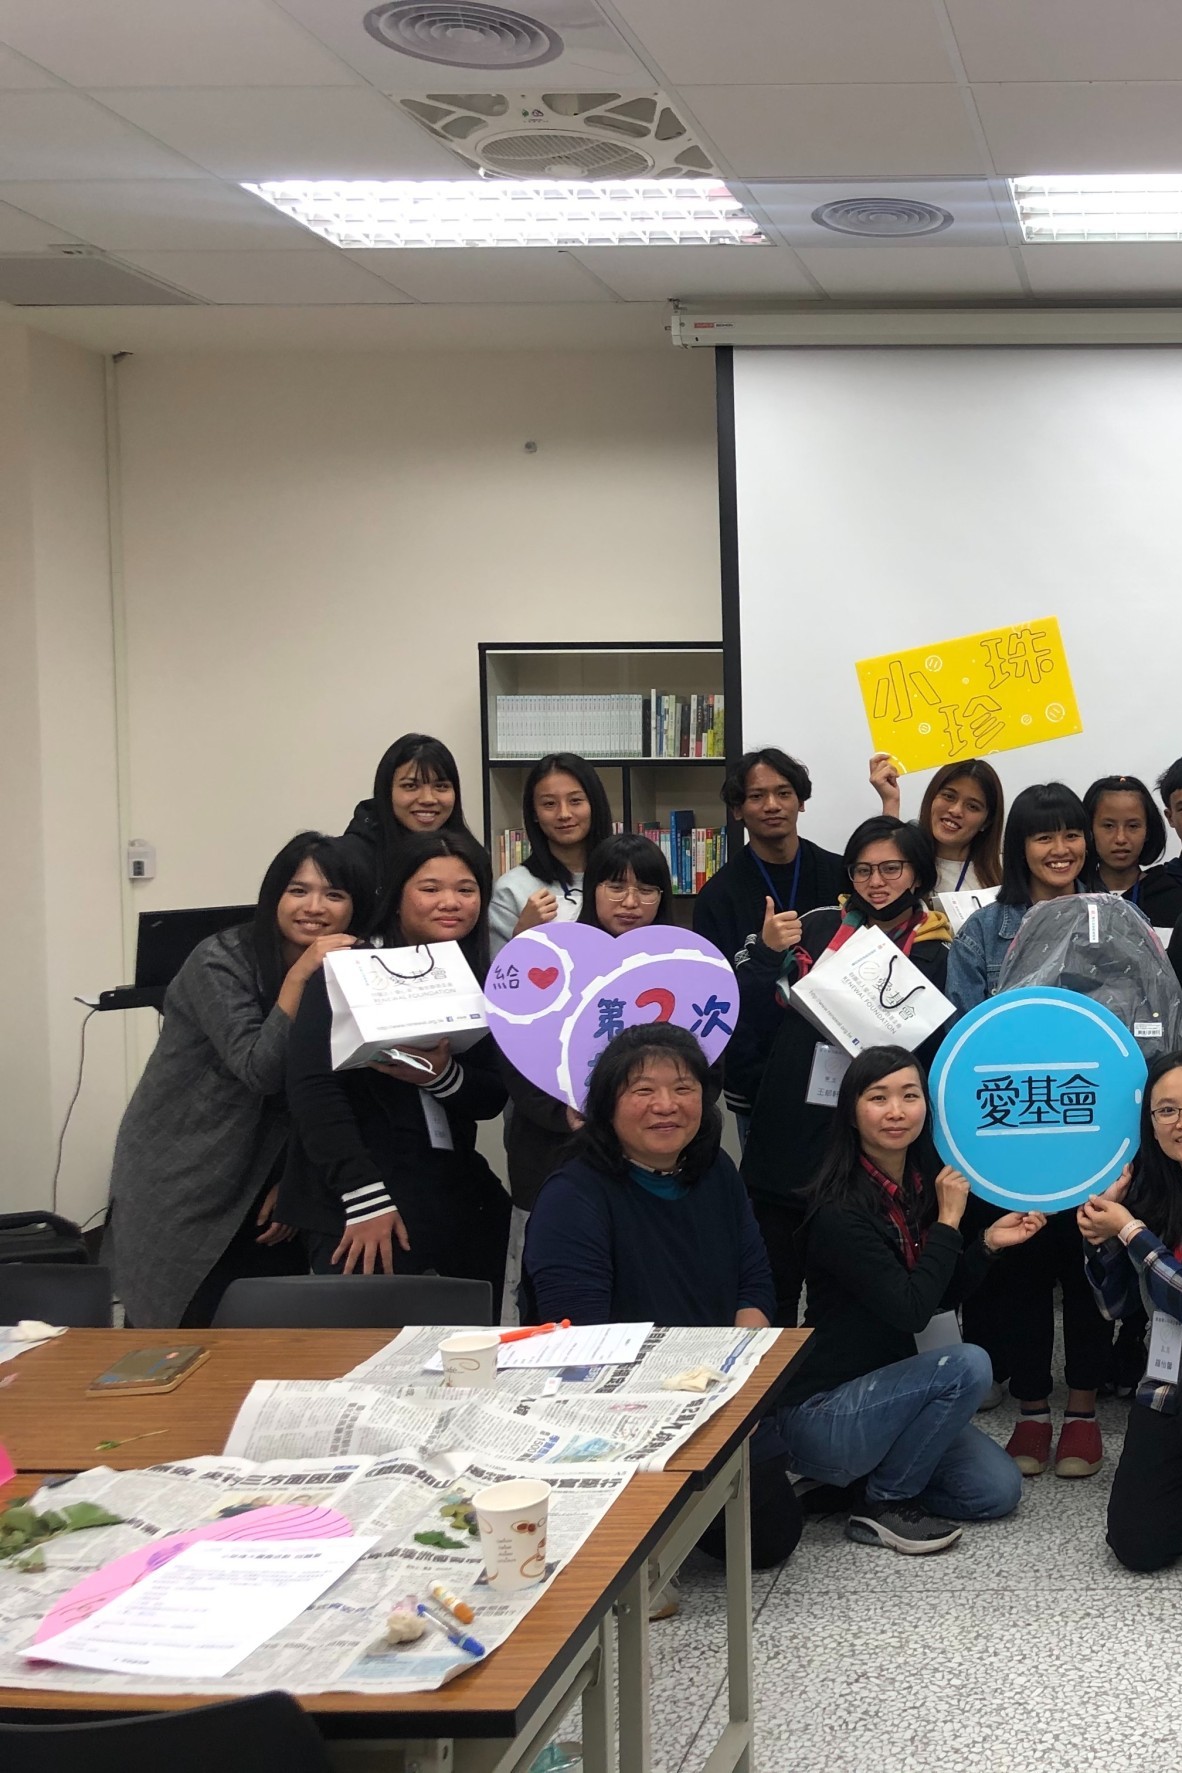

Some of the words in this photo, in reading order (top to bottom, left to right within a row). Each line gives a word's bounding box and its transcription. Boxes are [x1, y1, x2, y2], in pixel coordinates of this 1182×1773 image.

[873, 629, 1054, 757] 小珍珠
[493, 965, 520, 990] 給
[865, 998, 897, 1034] FOUNDATION
[976, 1073, 1100, 1130] 愛基會
